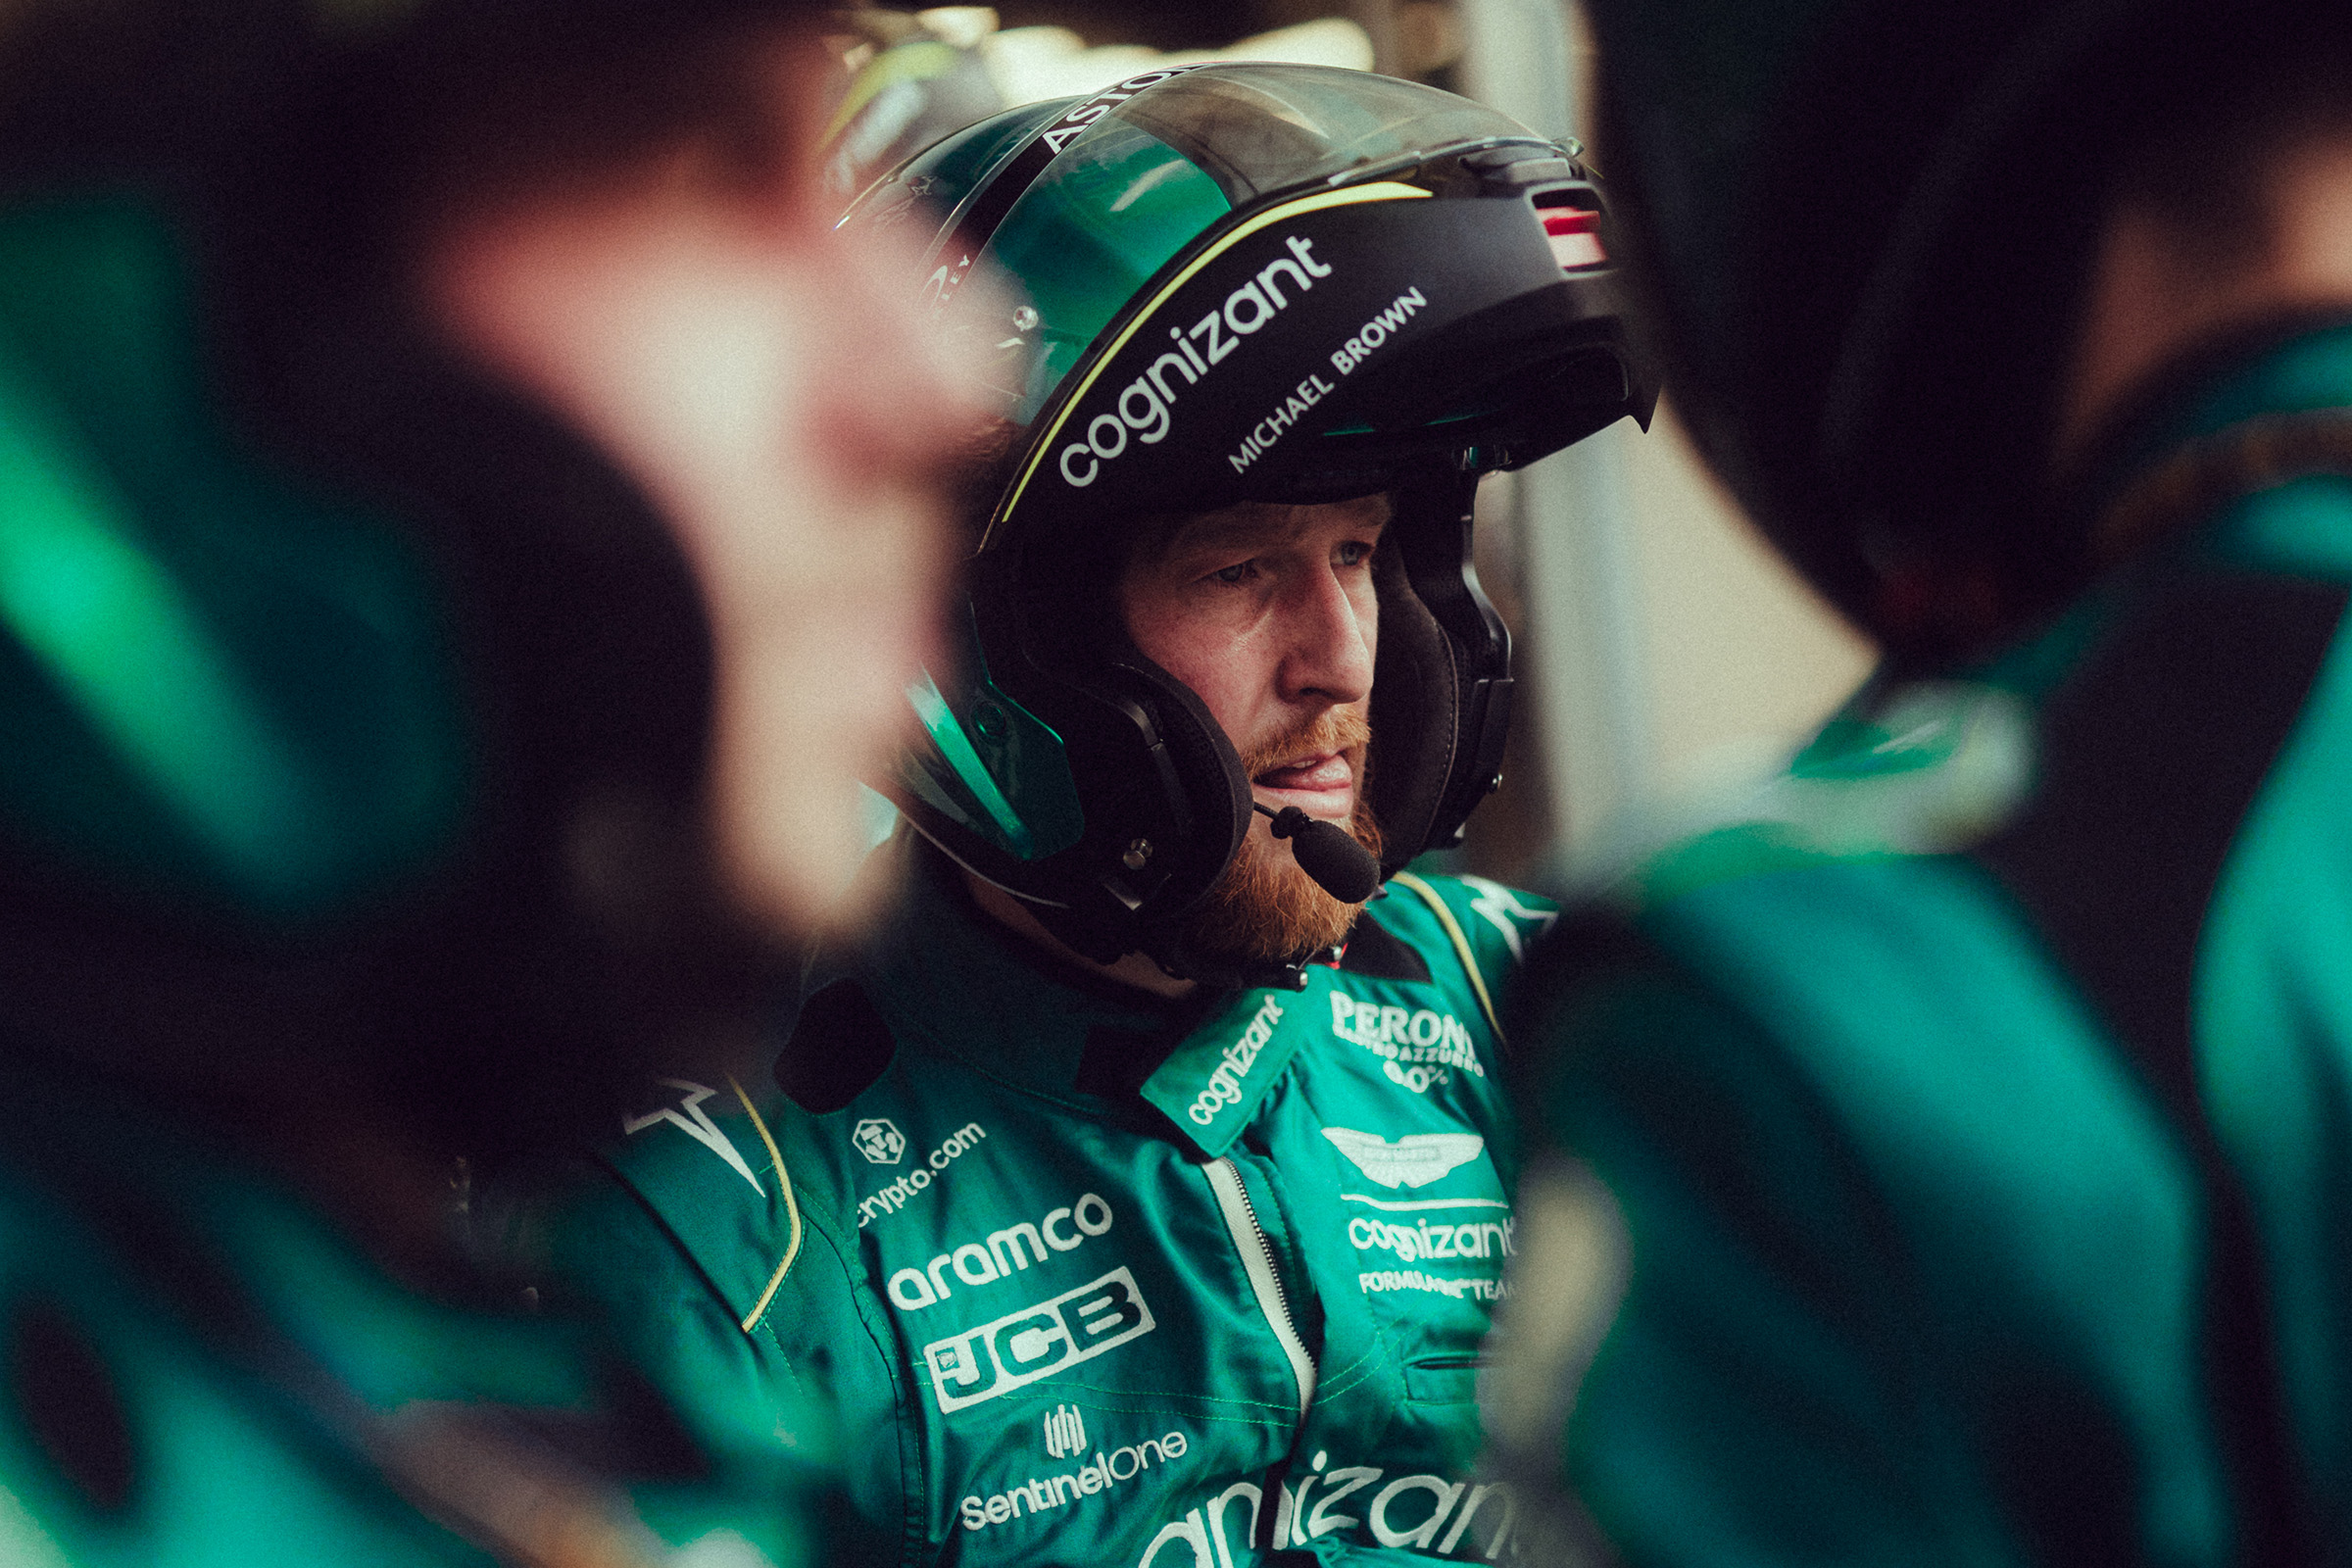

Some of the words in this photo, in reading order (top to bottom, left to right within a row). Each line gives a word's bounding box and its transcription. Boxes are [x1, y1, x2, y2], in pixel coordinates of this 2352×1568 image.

[1059, 235, 1332, 487] cognizant
[1228, 373, 1335, 474] MICHAEL
[1330, 285, 1428, 375] BROWN
[1188, 994, 1284, 1126] cognizant
[858, 1122, 986, 1228] crypto.com
[887, 1192, 1113, 1311] aramco
[1348, 1214, 1518, 1262] cognizant
[933, 1280, 1144, 1400] JCB
[959, 1431, 1189, 1531] SentinelOne
